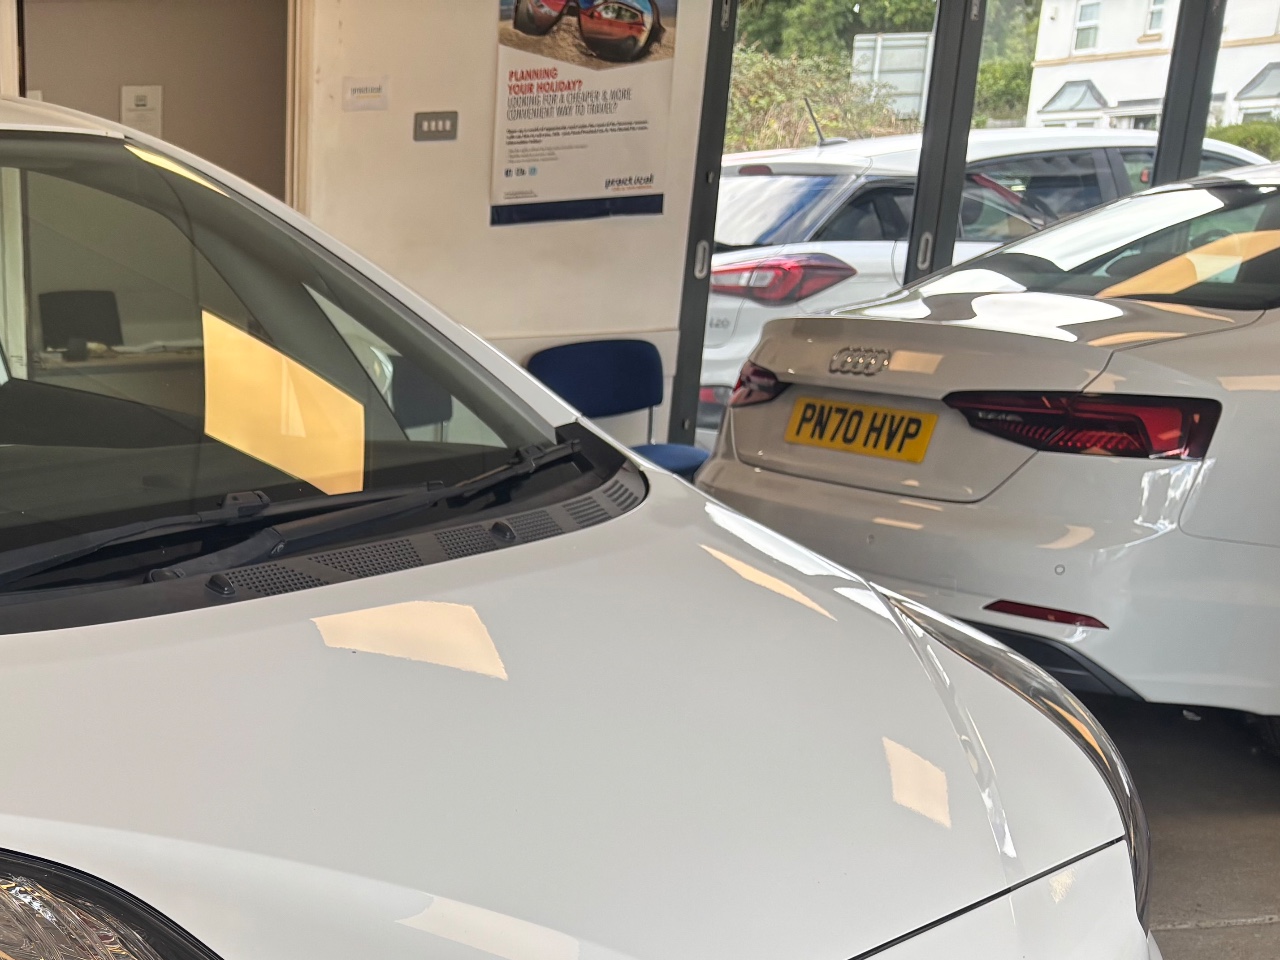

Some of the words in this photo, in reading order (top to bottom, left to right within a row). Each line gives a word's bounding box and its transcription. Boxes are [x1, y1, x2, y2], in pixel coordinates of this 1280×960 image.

[508, 67, 558, 82] PLANNING
[508, 83, 534, 95] YOUR
[536, 79, 583, 94] HOLIDAY?
[795, 402, 864, 445] PN70
[862, 411, 923, 454] HVP
